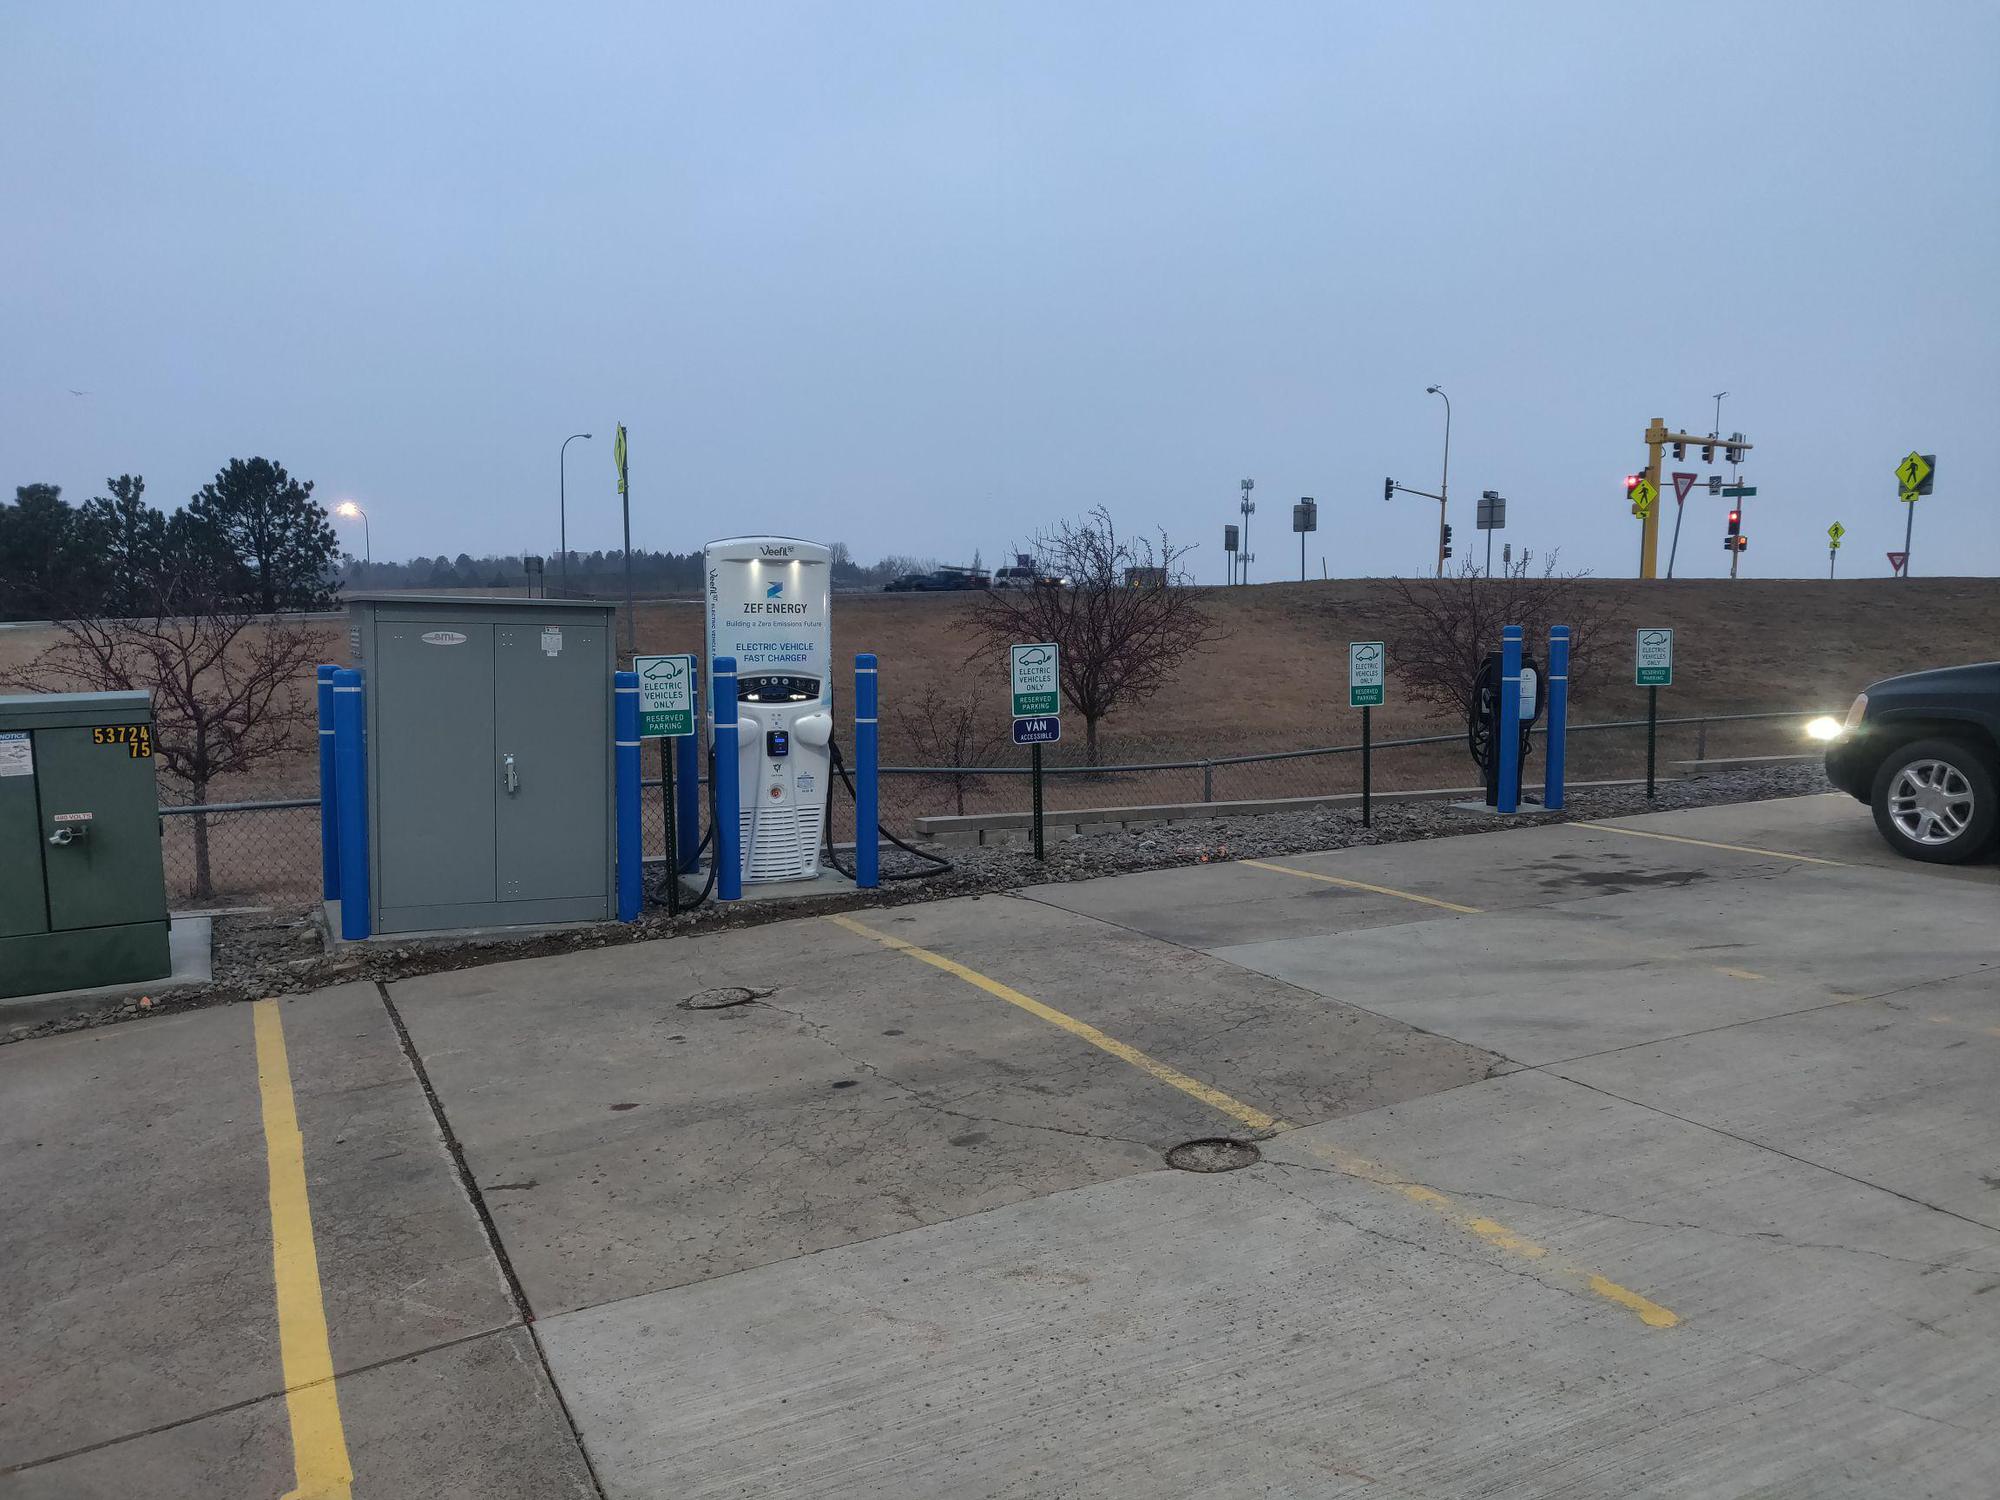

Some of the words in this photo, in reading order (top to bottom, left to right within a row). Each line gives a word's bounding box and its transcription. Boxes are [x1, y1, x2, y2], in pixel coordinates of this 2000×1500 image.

[760, 545, 788, 556] Veefil
[743, 603, 763, 614] ZEF
[766, 603, 808, 614] ENERGY
[726, 620, 751, 628] Building
[736, 642, 778, 651] ELECTRIC
[780, 642, 814, 651] VEHICLE
[743, 654, 766, 662] FAST
[767, 653, 808, 662] CHARGER
[1355, 662, 1379, 670] ELECTRIC
[1019, 667, 1051, 676] ELECTRIC
[1019, 675, 1051, 683] VEHICLES
[644, 682, 682, 691] ELECTRIC
[644, 691, 684, 700] VEHICLES
[1019, 695, 1052, 704] RESERVED
[653, 700, 675, 709] ONLY
[1022, 702, 1050, 711] PARKING
[646, 714, 684, 723] RESERVED
[649, 722, 682, 731] PARKING
[1026, 720, 1047, 732] VAN
[0, 732, 27, 740] NOTICE
[94, 726, 149, 744] 53724
[1020, 732, 1053, 740] ACCESSIBLE
[130, 742, 150, 757] 75
